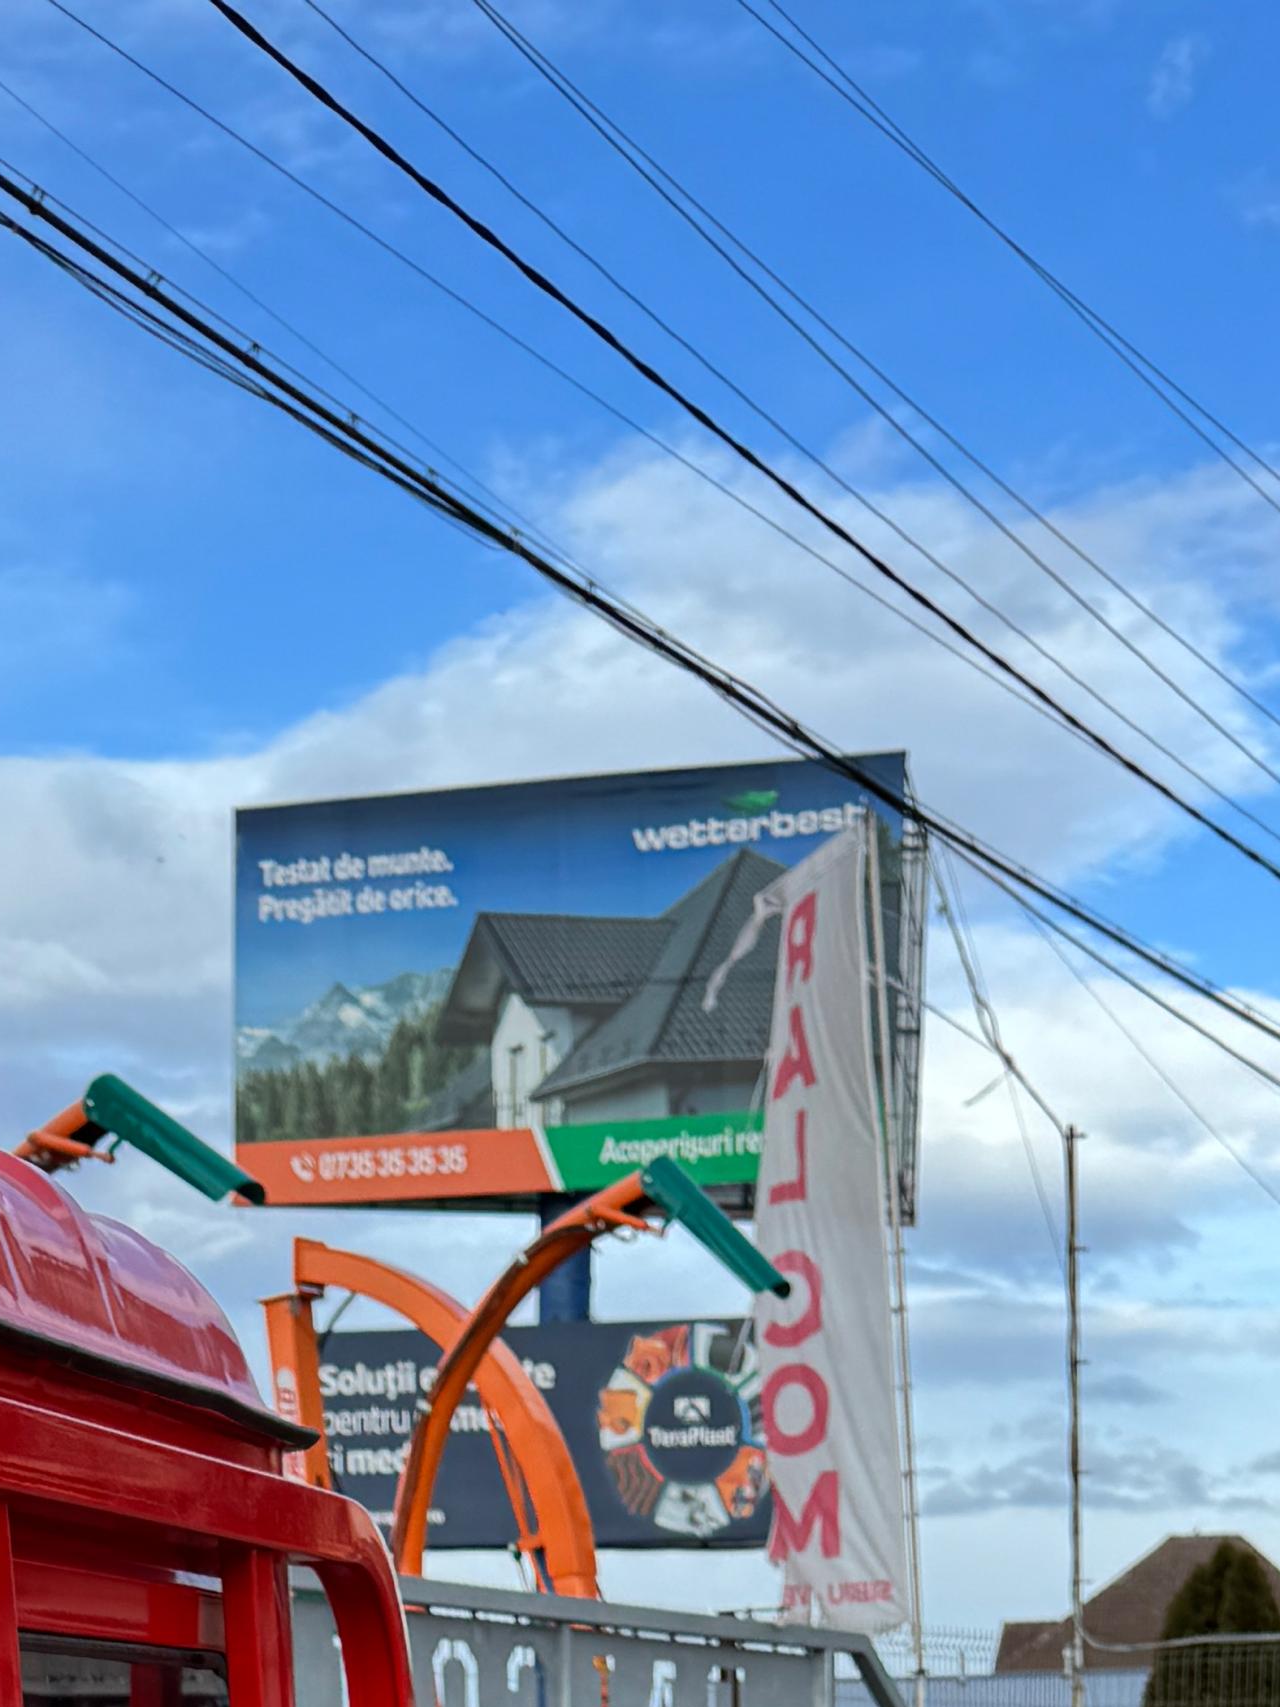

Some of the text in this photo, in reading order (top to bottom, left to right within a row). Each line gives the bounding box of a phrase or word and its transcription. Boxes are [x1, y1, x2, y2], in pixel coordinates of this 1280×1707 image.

[632, 802, 866, 852] wetterbest
[258, 845, 455, 888] Testat de munte.
[356, 885, 387, 914] de
[389, 879, 459, 911] orice.
